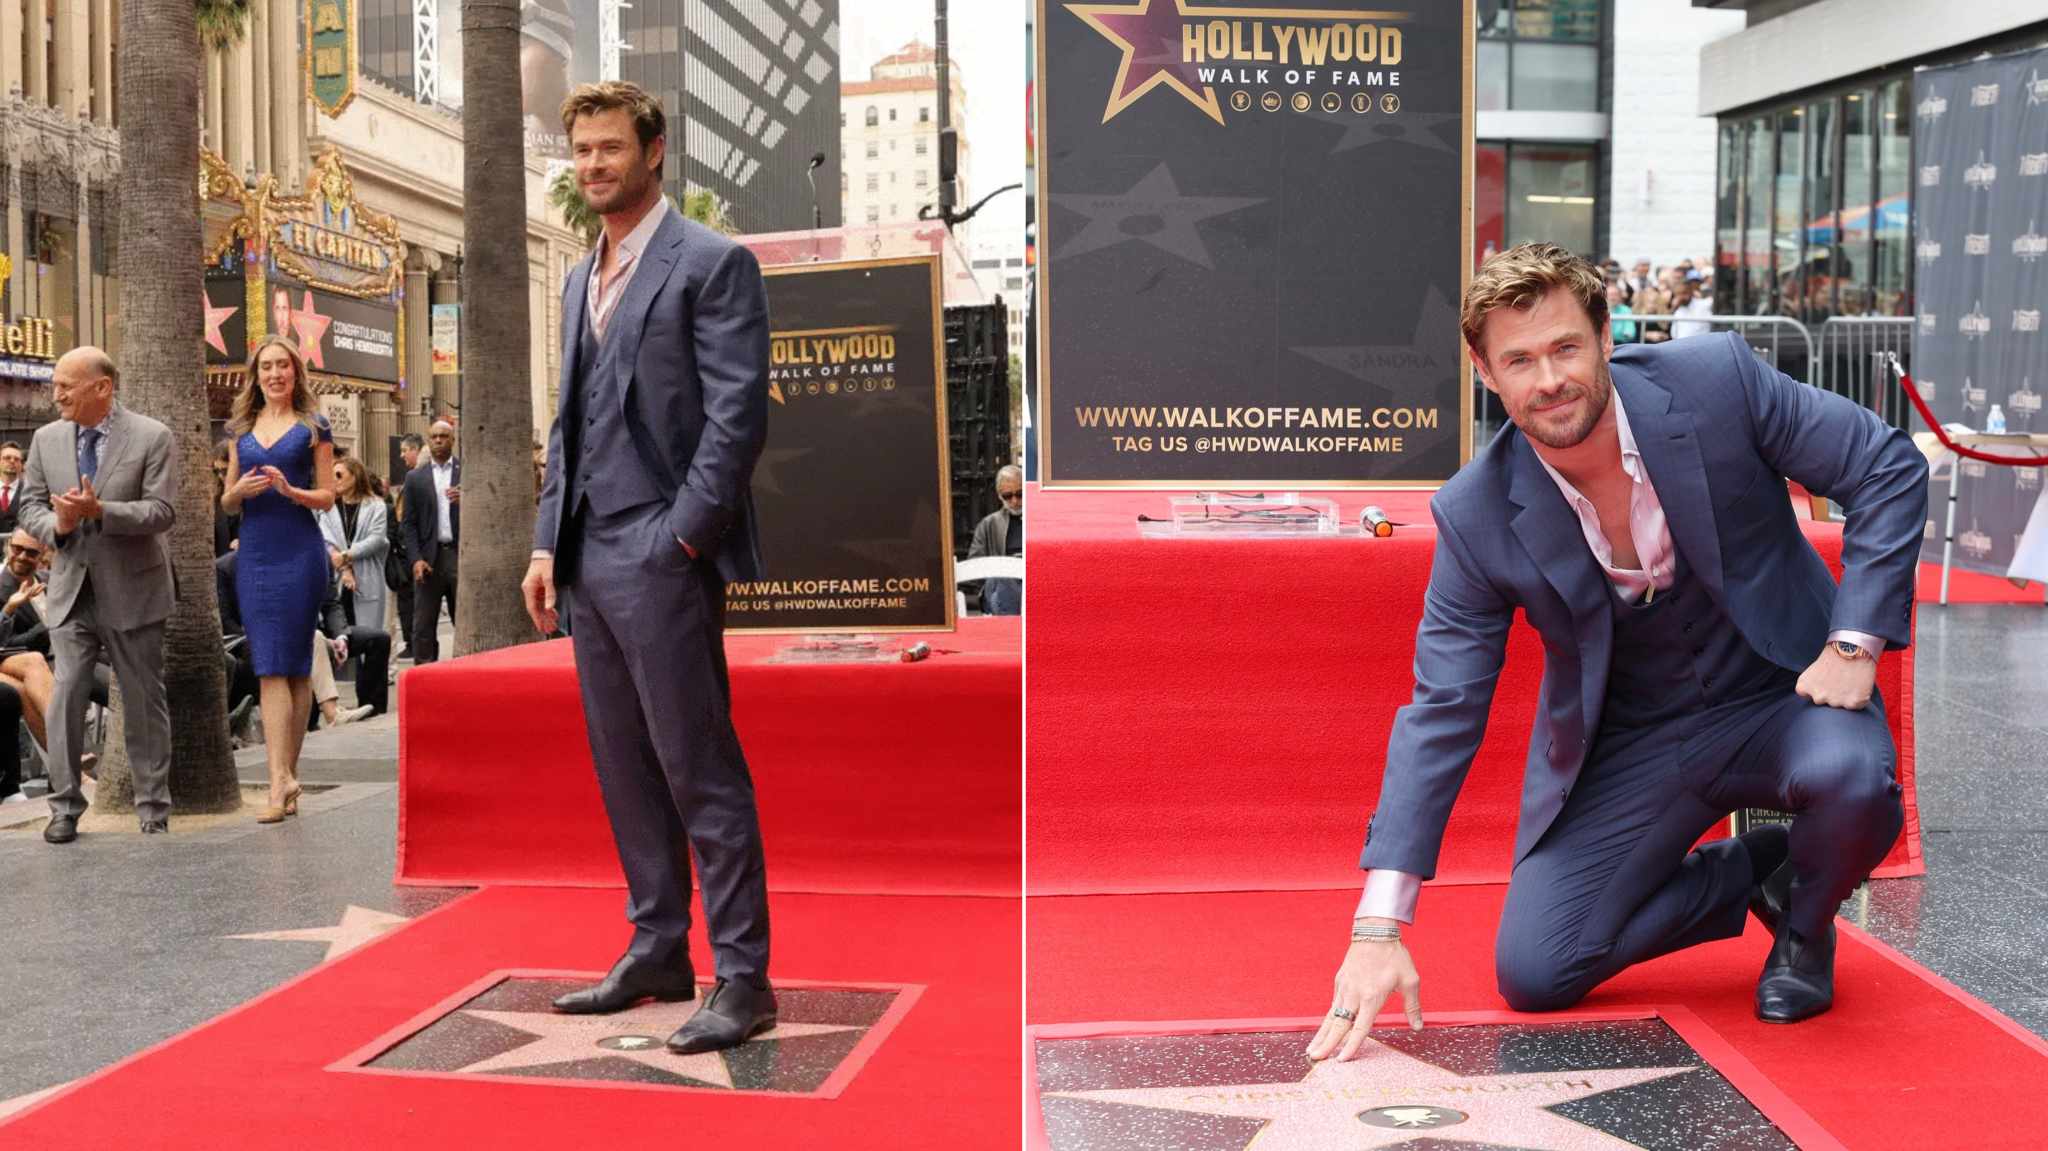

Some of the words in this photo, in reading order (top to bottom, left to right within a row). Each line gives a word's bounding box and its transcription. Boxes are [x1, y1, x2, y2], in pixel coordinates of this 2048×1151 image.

[1182, 20, 1402, 66] HOLLYWOOD
[1197, 68, 1270, 84] WALK
[1284, 70, 1317, 85] OF
[1332, 71, 1401, 86] FAME
[0, 312, 56, 358] elli
[333, 320, 393, 345] CONGRATULATIONS
[769, 334, 896, 366] OLLYWOOD
[820, 366, 841, 376] OF
[850, 362, 895, 375] FAME
[1074, 407, 1438, 429] WWW.WALKOFFAME.COM
[1112, 436, 1153, 452] TAG
[1160, 436, 1188, 452] US
[1194, 436, 1403, 453] @HWDWALKOFFAME
[752, 599, 771, 611] US
[774, 597, 907, 610] @HWDWALKOFFAME
